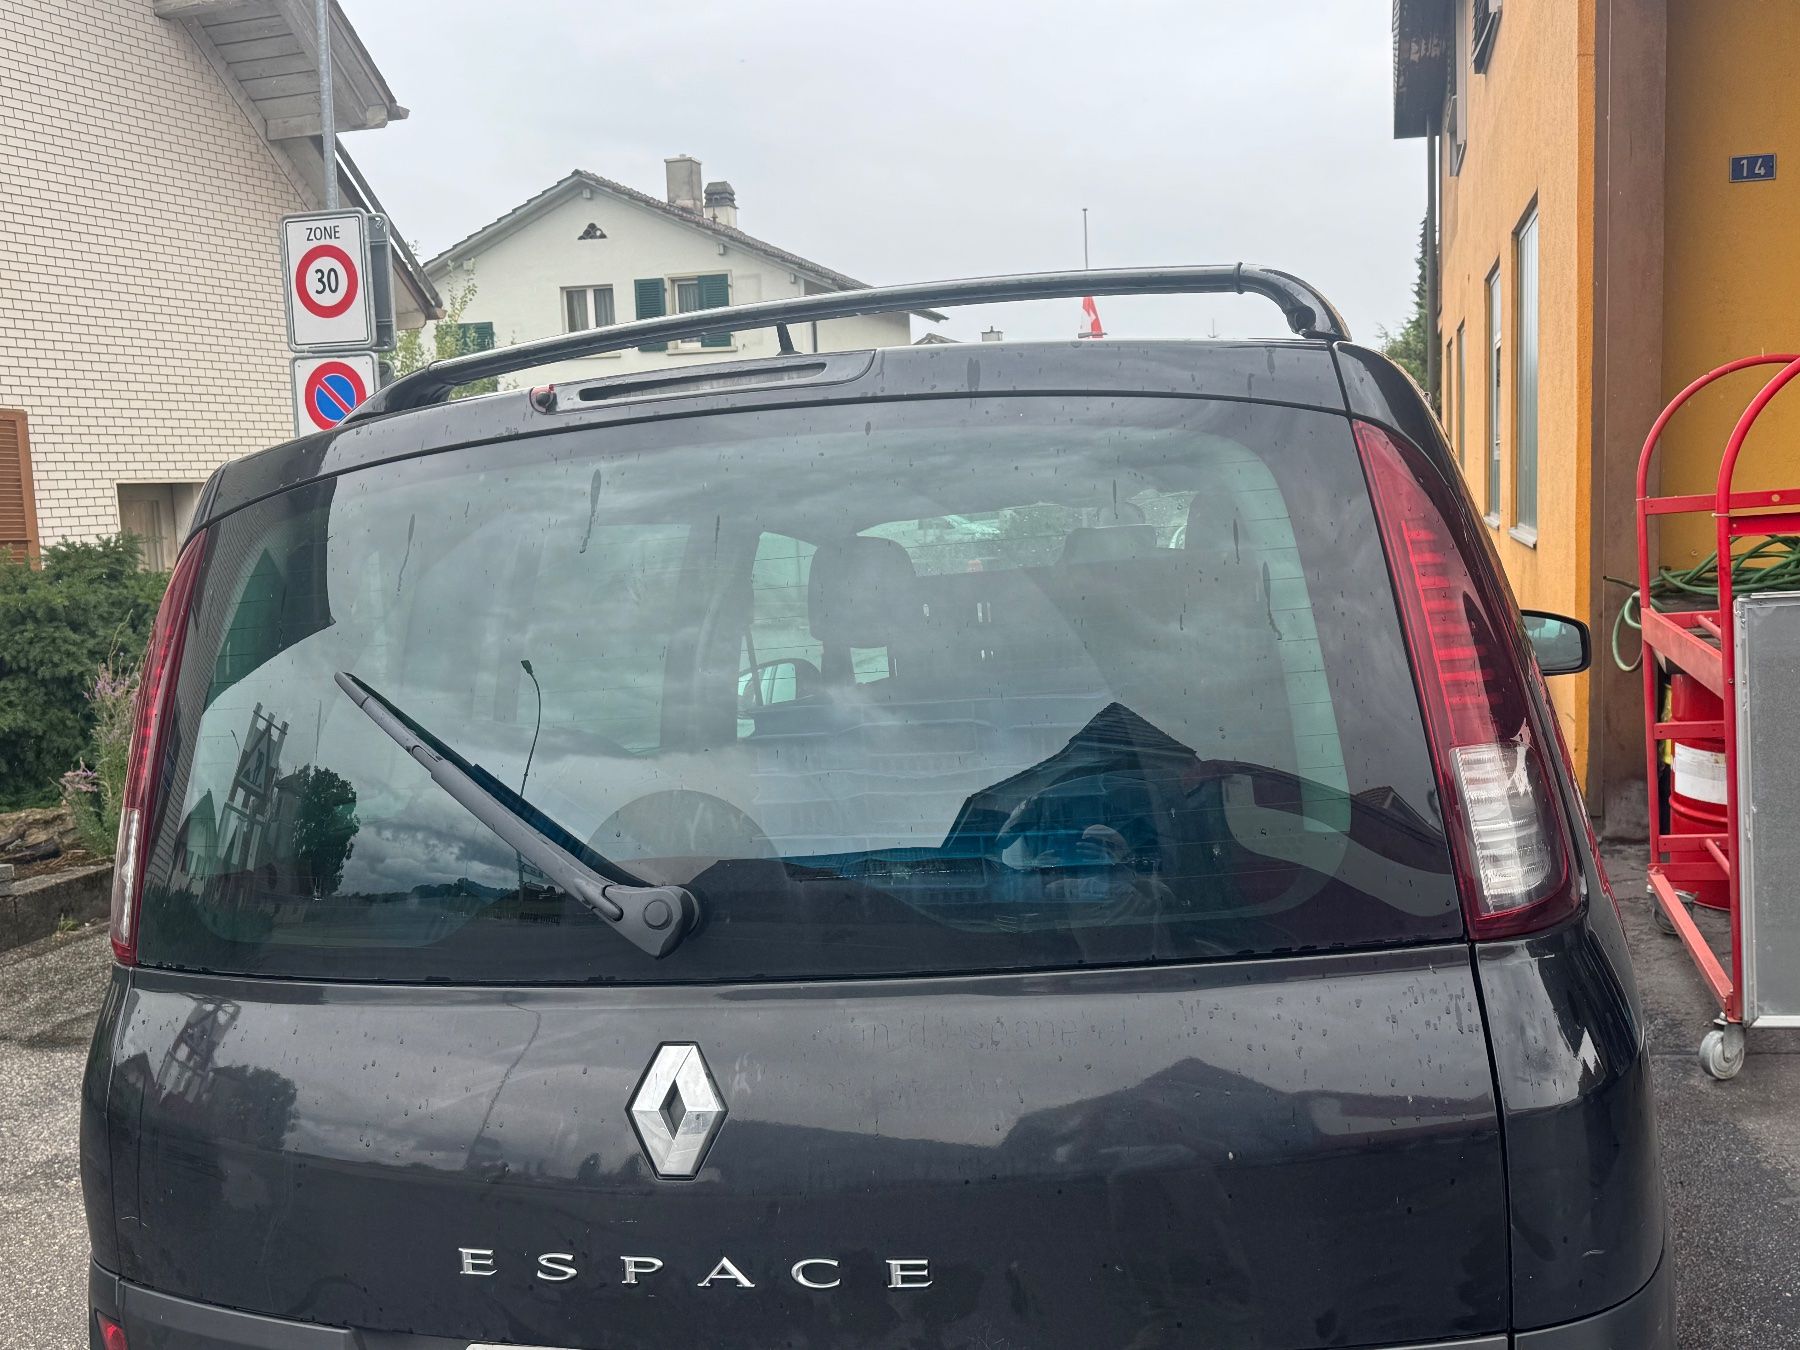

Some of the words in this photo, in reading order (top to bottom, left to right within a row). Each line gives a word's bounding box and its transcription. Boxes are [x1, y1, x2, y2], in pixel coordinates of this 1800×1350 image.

[1740, 158, 1766, 177] 14
[305, 225, 341, 241] ZONE
[314, 267, 339, 294] 30
[458, 1247, 933, 1289] ESPACE
